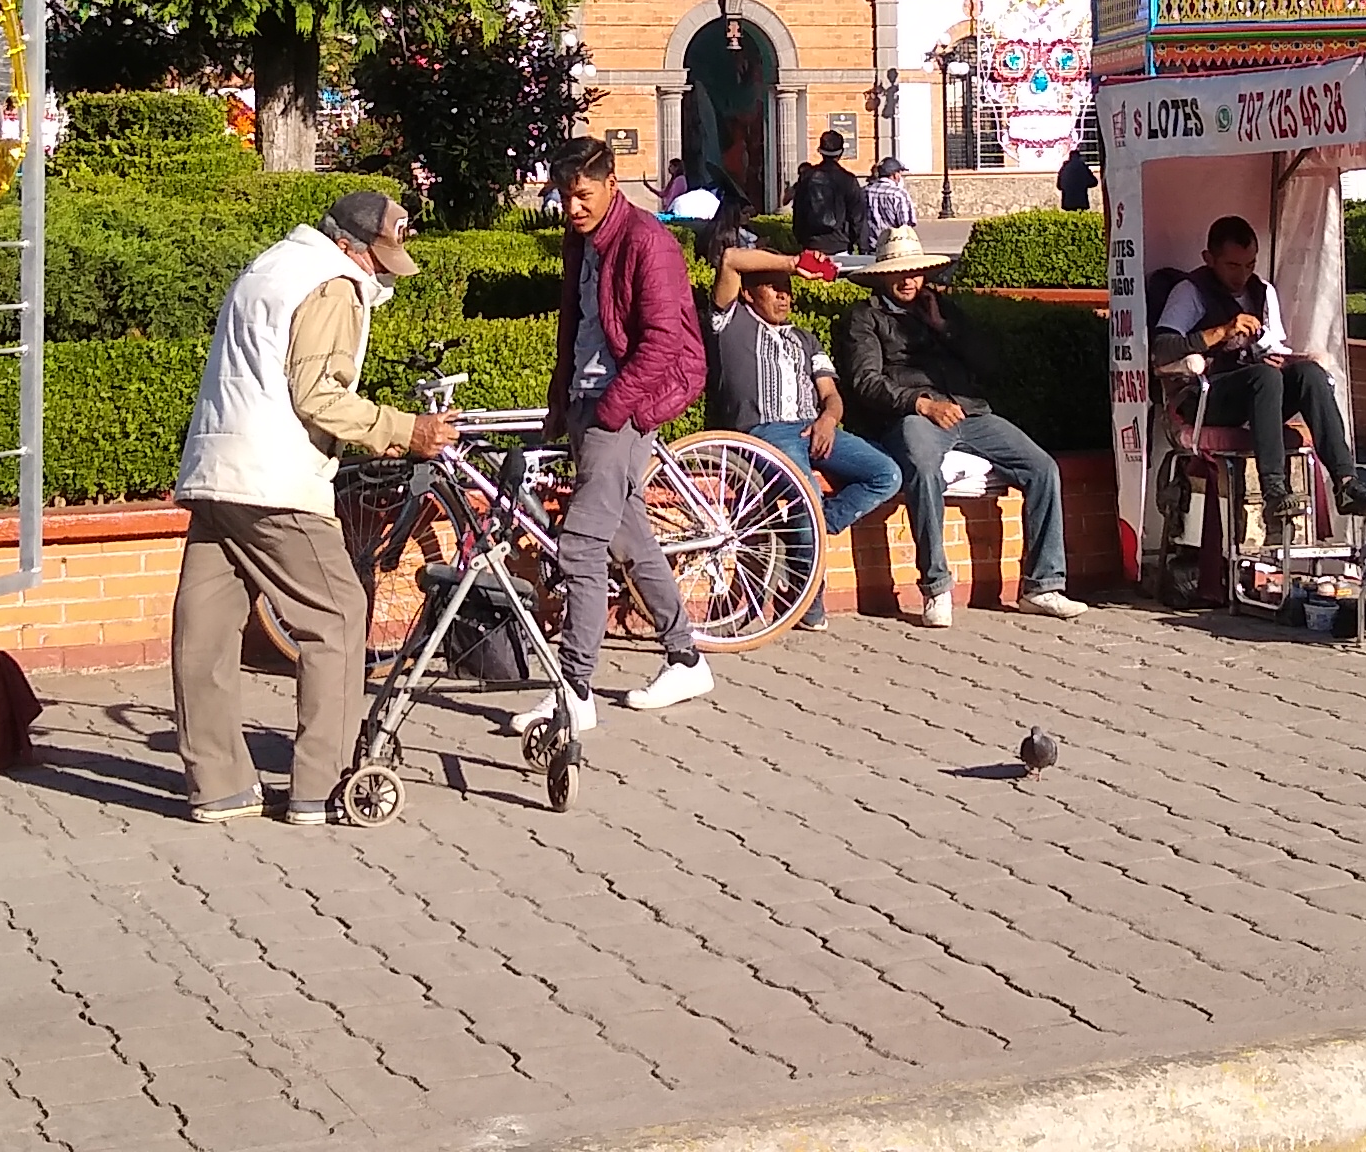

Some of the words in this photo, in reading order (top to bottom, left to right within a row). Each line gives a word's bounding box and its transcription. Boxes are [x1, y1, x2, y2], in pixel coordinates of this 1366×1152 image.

[1134, 107, 1142, 139] $
[1147, 97, 1204, 139] LOTES
[1237, 91, 1264, 142] 797
[1267, 89, 1298, 139] 125
[1299, 85, 1321, 136] 46
[1116, 201, 1125, 229] $
[1111, 239, 1135, 258] OTES
